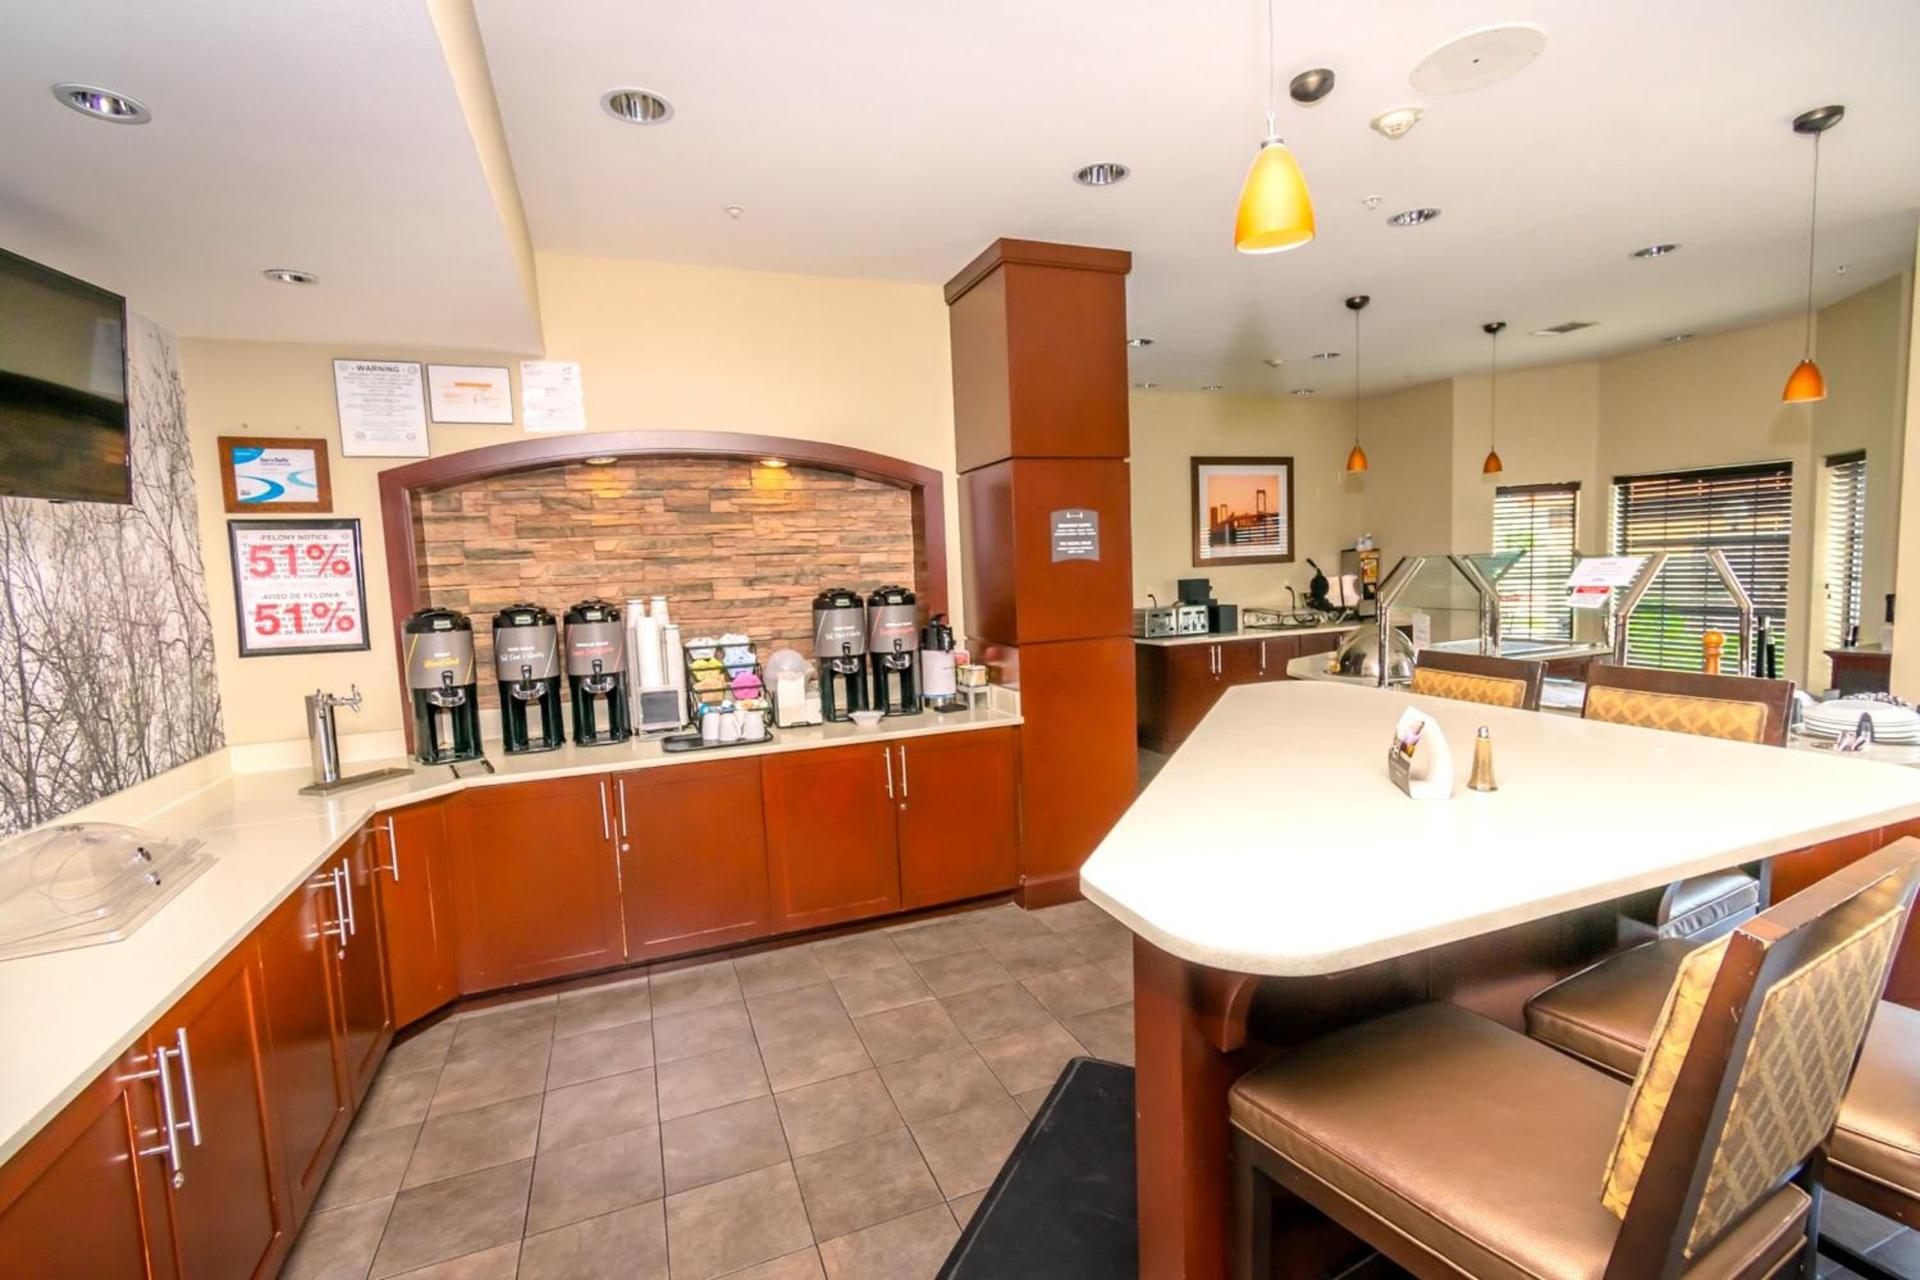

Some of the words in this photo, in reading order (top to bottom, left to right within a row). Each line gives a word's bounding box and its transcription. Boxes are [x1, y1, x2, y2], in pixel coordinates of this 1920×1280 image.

[356, 364, 400, 373] WARNING
[249, 543, 351, 577] 51%
[263, 592, 288, 600] AVISO
[255, 602, 355, 635] 51%
